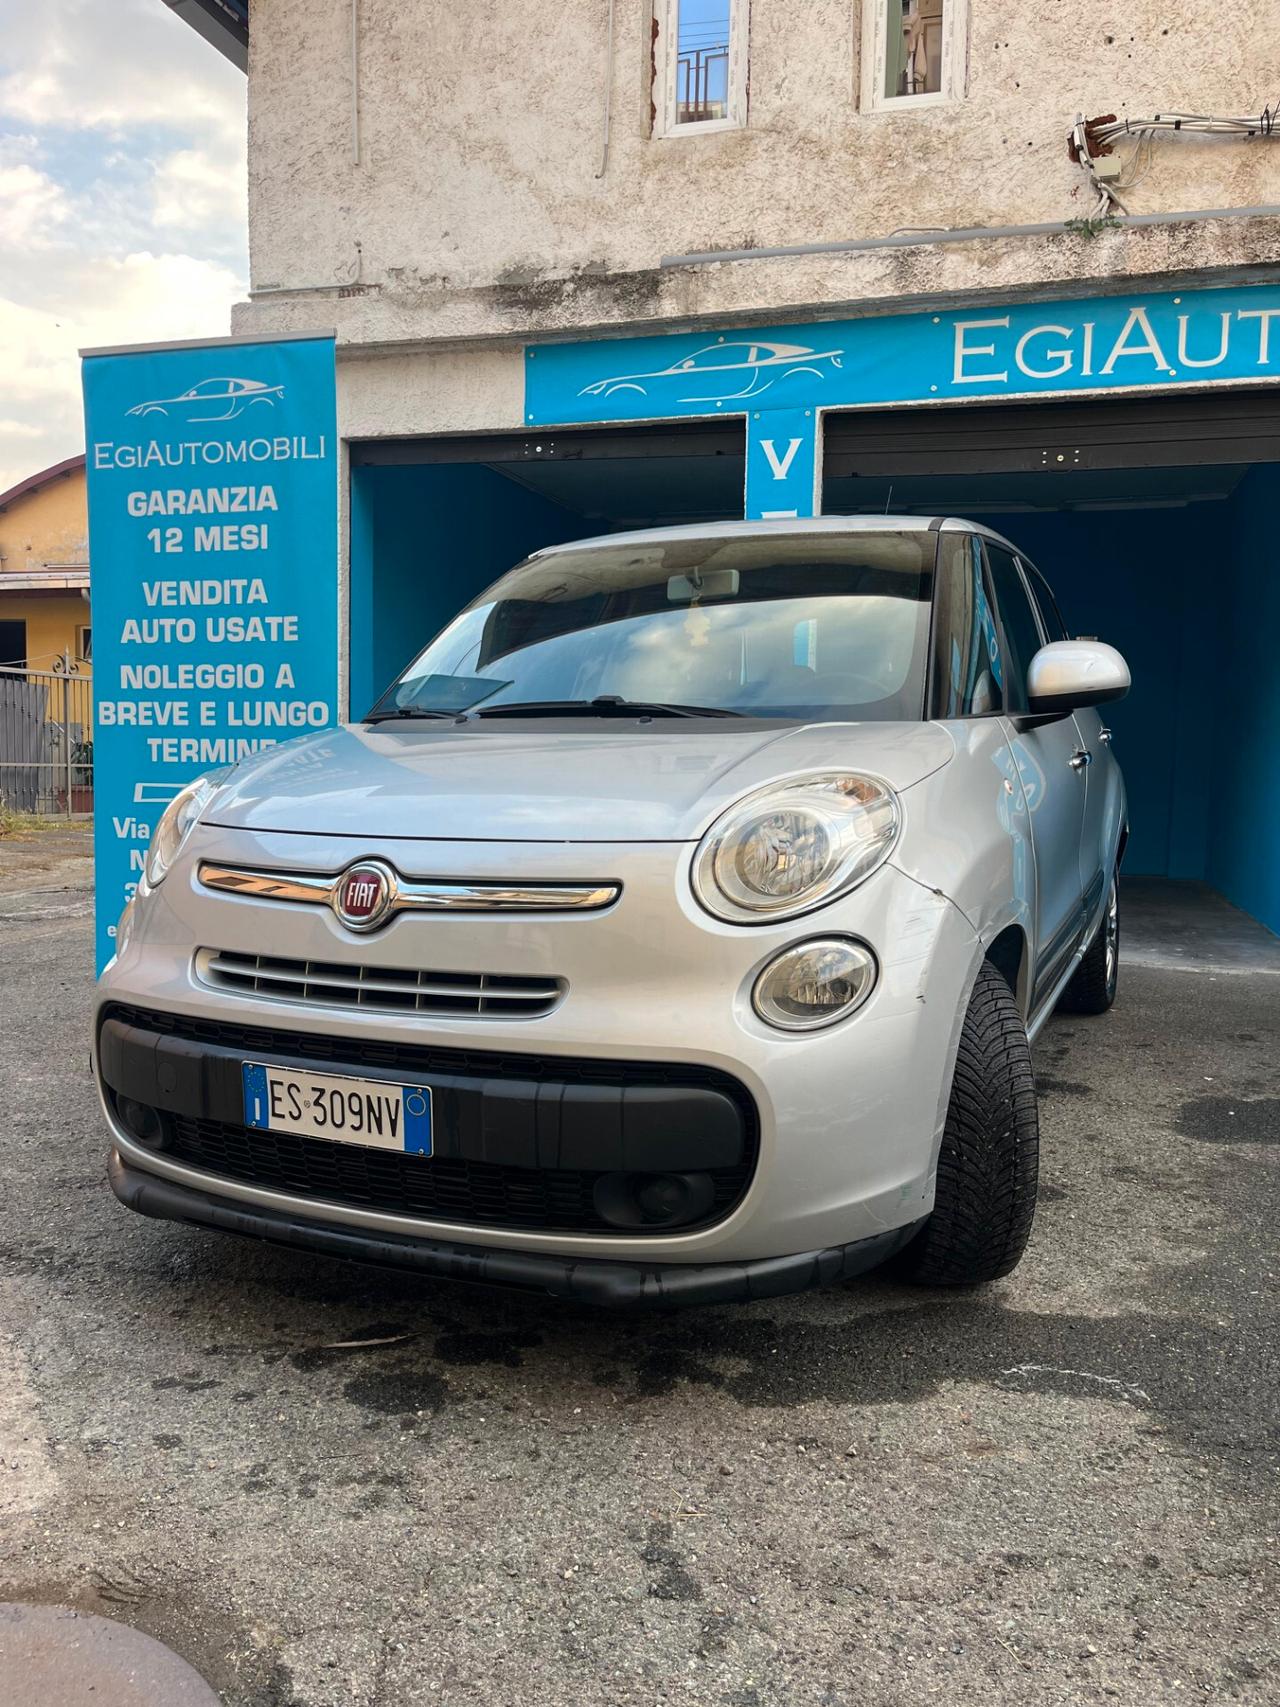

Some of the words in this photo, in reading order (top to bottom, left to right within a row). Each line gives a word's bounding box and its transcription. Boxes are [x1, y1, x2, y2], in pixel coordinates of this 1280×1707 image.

[127, 485, 278, 517] GARANZIA
[147, 527, 183, 553] 12
[194, 524, 268, 552] MESI
[142, 578, 268, 606] VENDITA
[120, 617, 196, 644] AUTO
[206, 615, 299, 643] USATE
[120, 663, 265, 689] NOLEGGIO
[274, 663, 295, 688] A
[98, 701, 190, 726] BREVE
[199, 701, 216, 726] E
[227, 701, 329, 727] LUNGO
[147, 738, 277, 763] TERMIN
[112, 817, 150, 839] Via
[346, 882, 377, 907] FIAT
[269, 1079, 302, 1122] ES
[310, 1087, 401, 1138] 309NV
